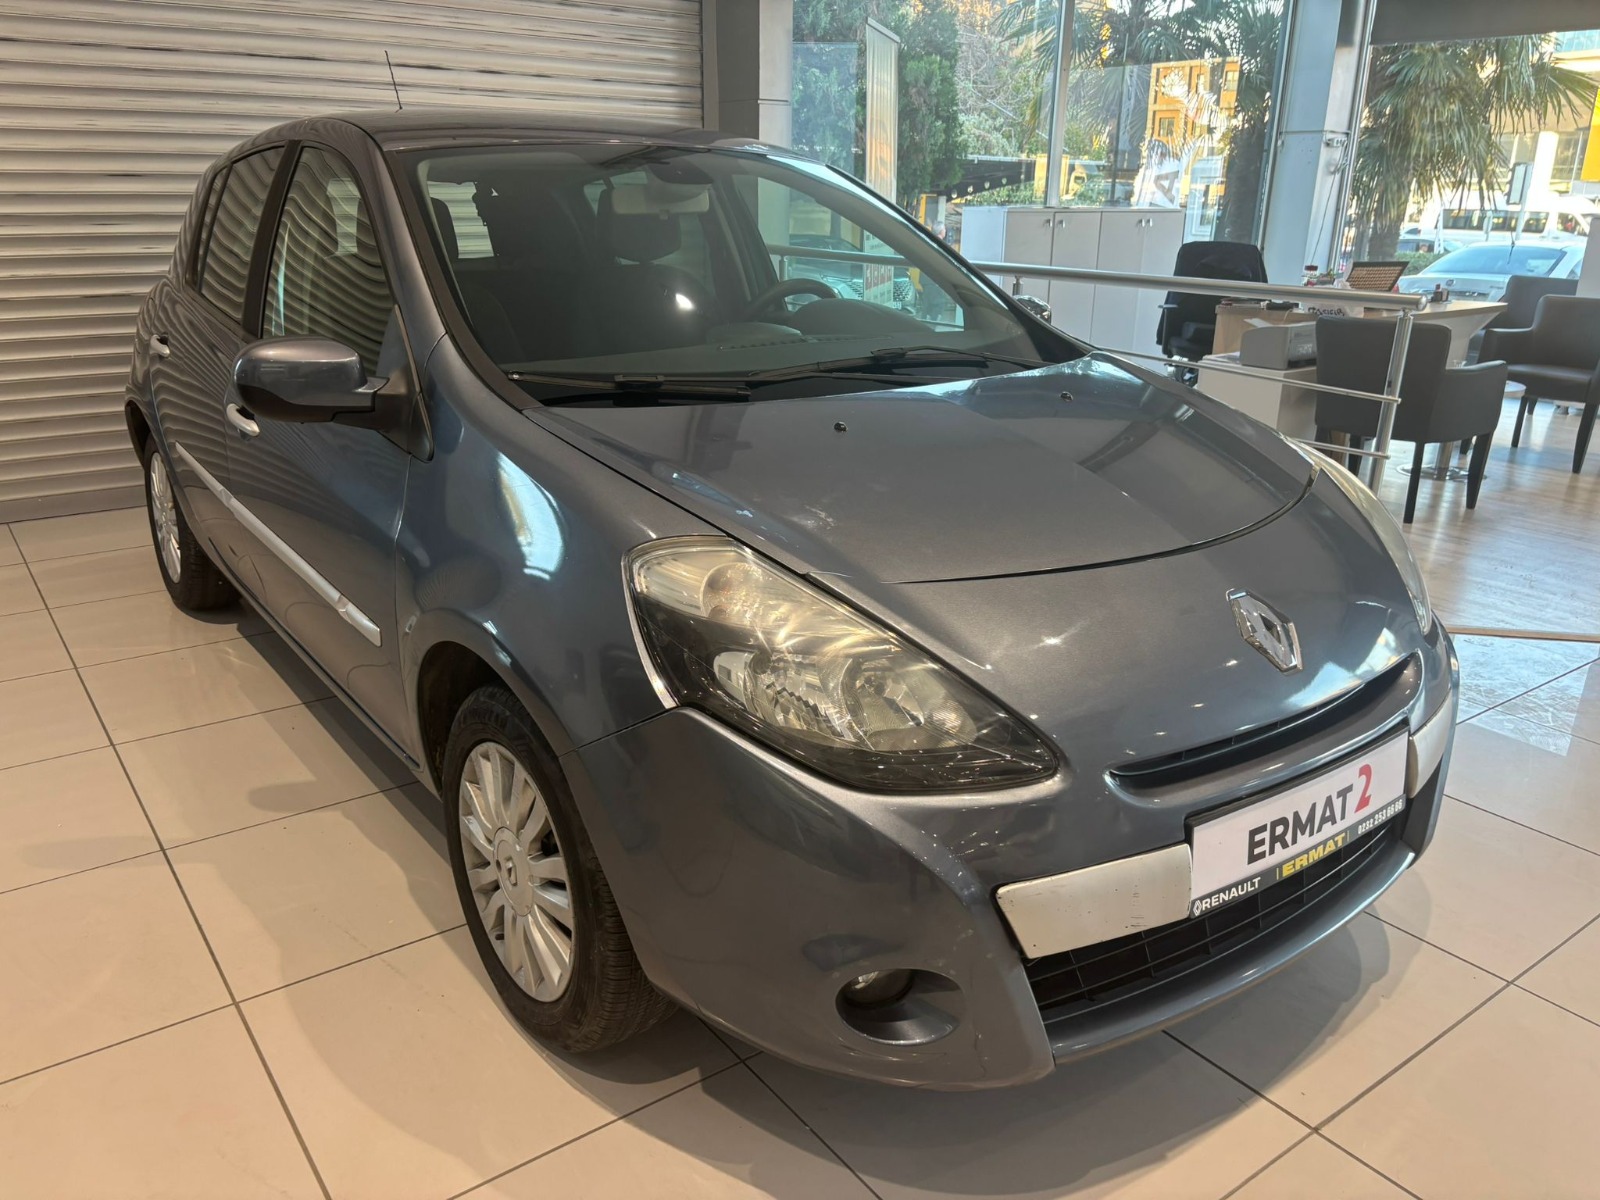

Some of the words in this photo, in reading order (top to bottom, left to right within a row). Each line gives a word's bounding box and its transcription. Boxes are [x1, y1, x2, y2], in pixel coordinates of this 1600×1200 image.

[1247, 783, 1353, 865] ERMAT
[1354, 763, 1372, 813] 2
[1202, 876, 1261, 911] RENAULT
[1282, 833, 1345, 877] ERMAT
